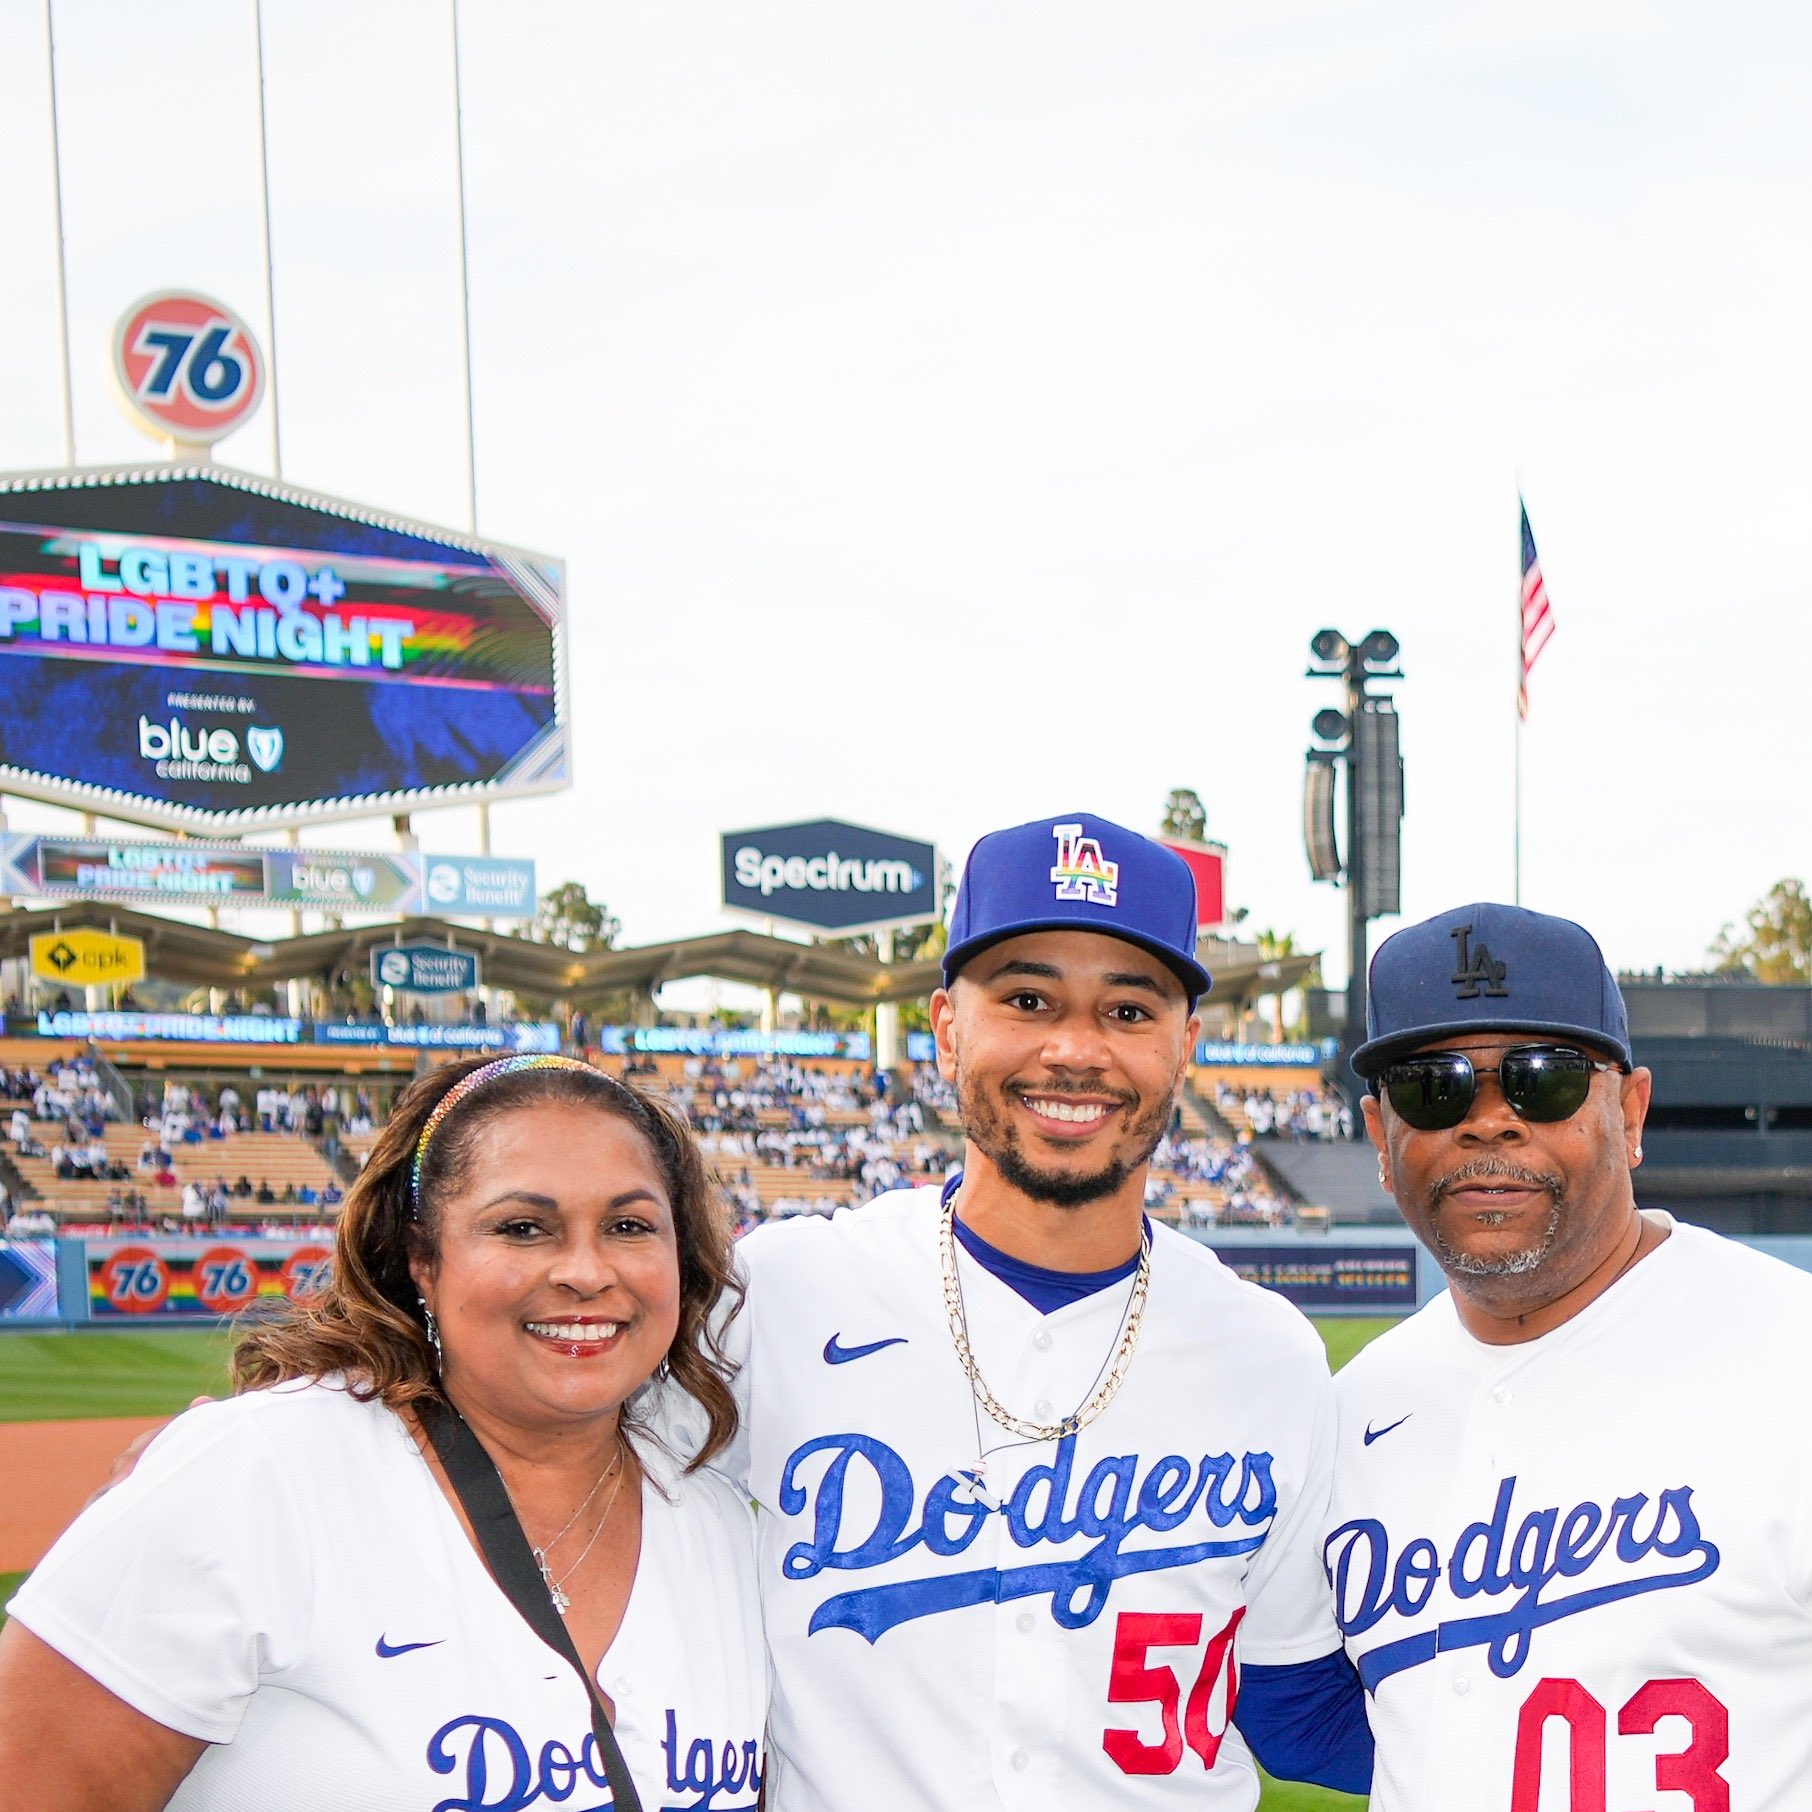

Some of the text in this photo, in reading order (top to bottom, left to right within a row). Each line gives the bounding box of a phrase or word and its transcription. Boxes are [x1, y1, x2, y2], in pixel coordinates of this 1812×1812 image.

[140, 326, 242, 402] 76
[80, 541, 346, 616] LGBTQ+
[0, 588, 413, 670] PRIDE NIGHT
[139, 715, 240, 764] blue
[156, 758, 252, 785] california
[292, 864, 350, 892] blue
[735, 847, 913, 895] Spectrum
[1051, 823, 1119, 907] LA
[1450, 923, 1509, 1000] LA
[112, 1261, 160, 1297] 76
[202, 1261, 248, 1297] 76
[778, 1417, 1279, 1645] Dodgers
[1322, 1475, 1721, 1702] Dodgers
